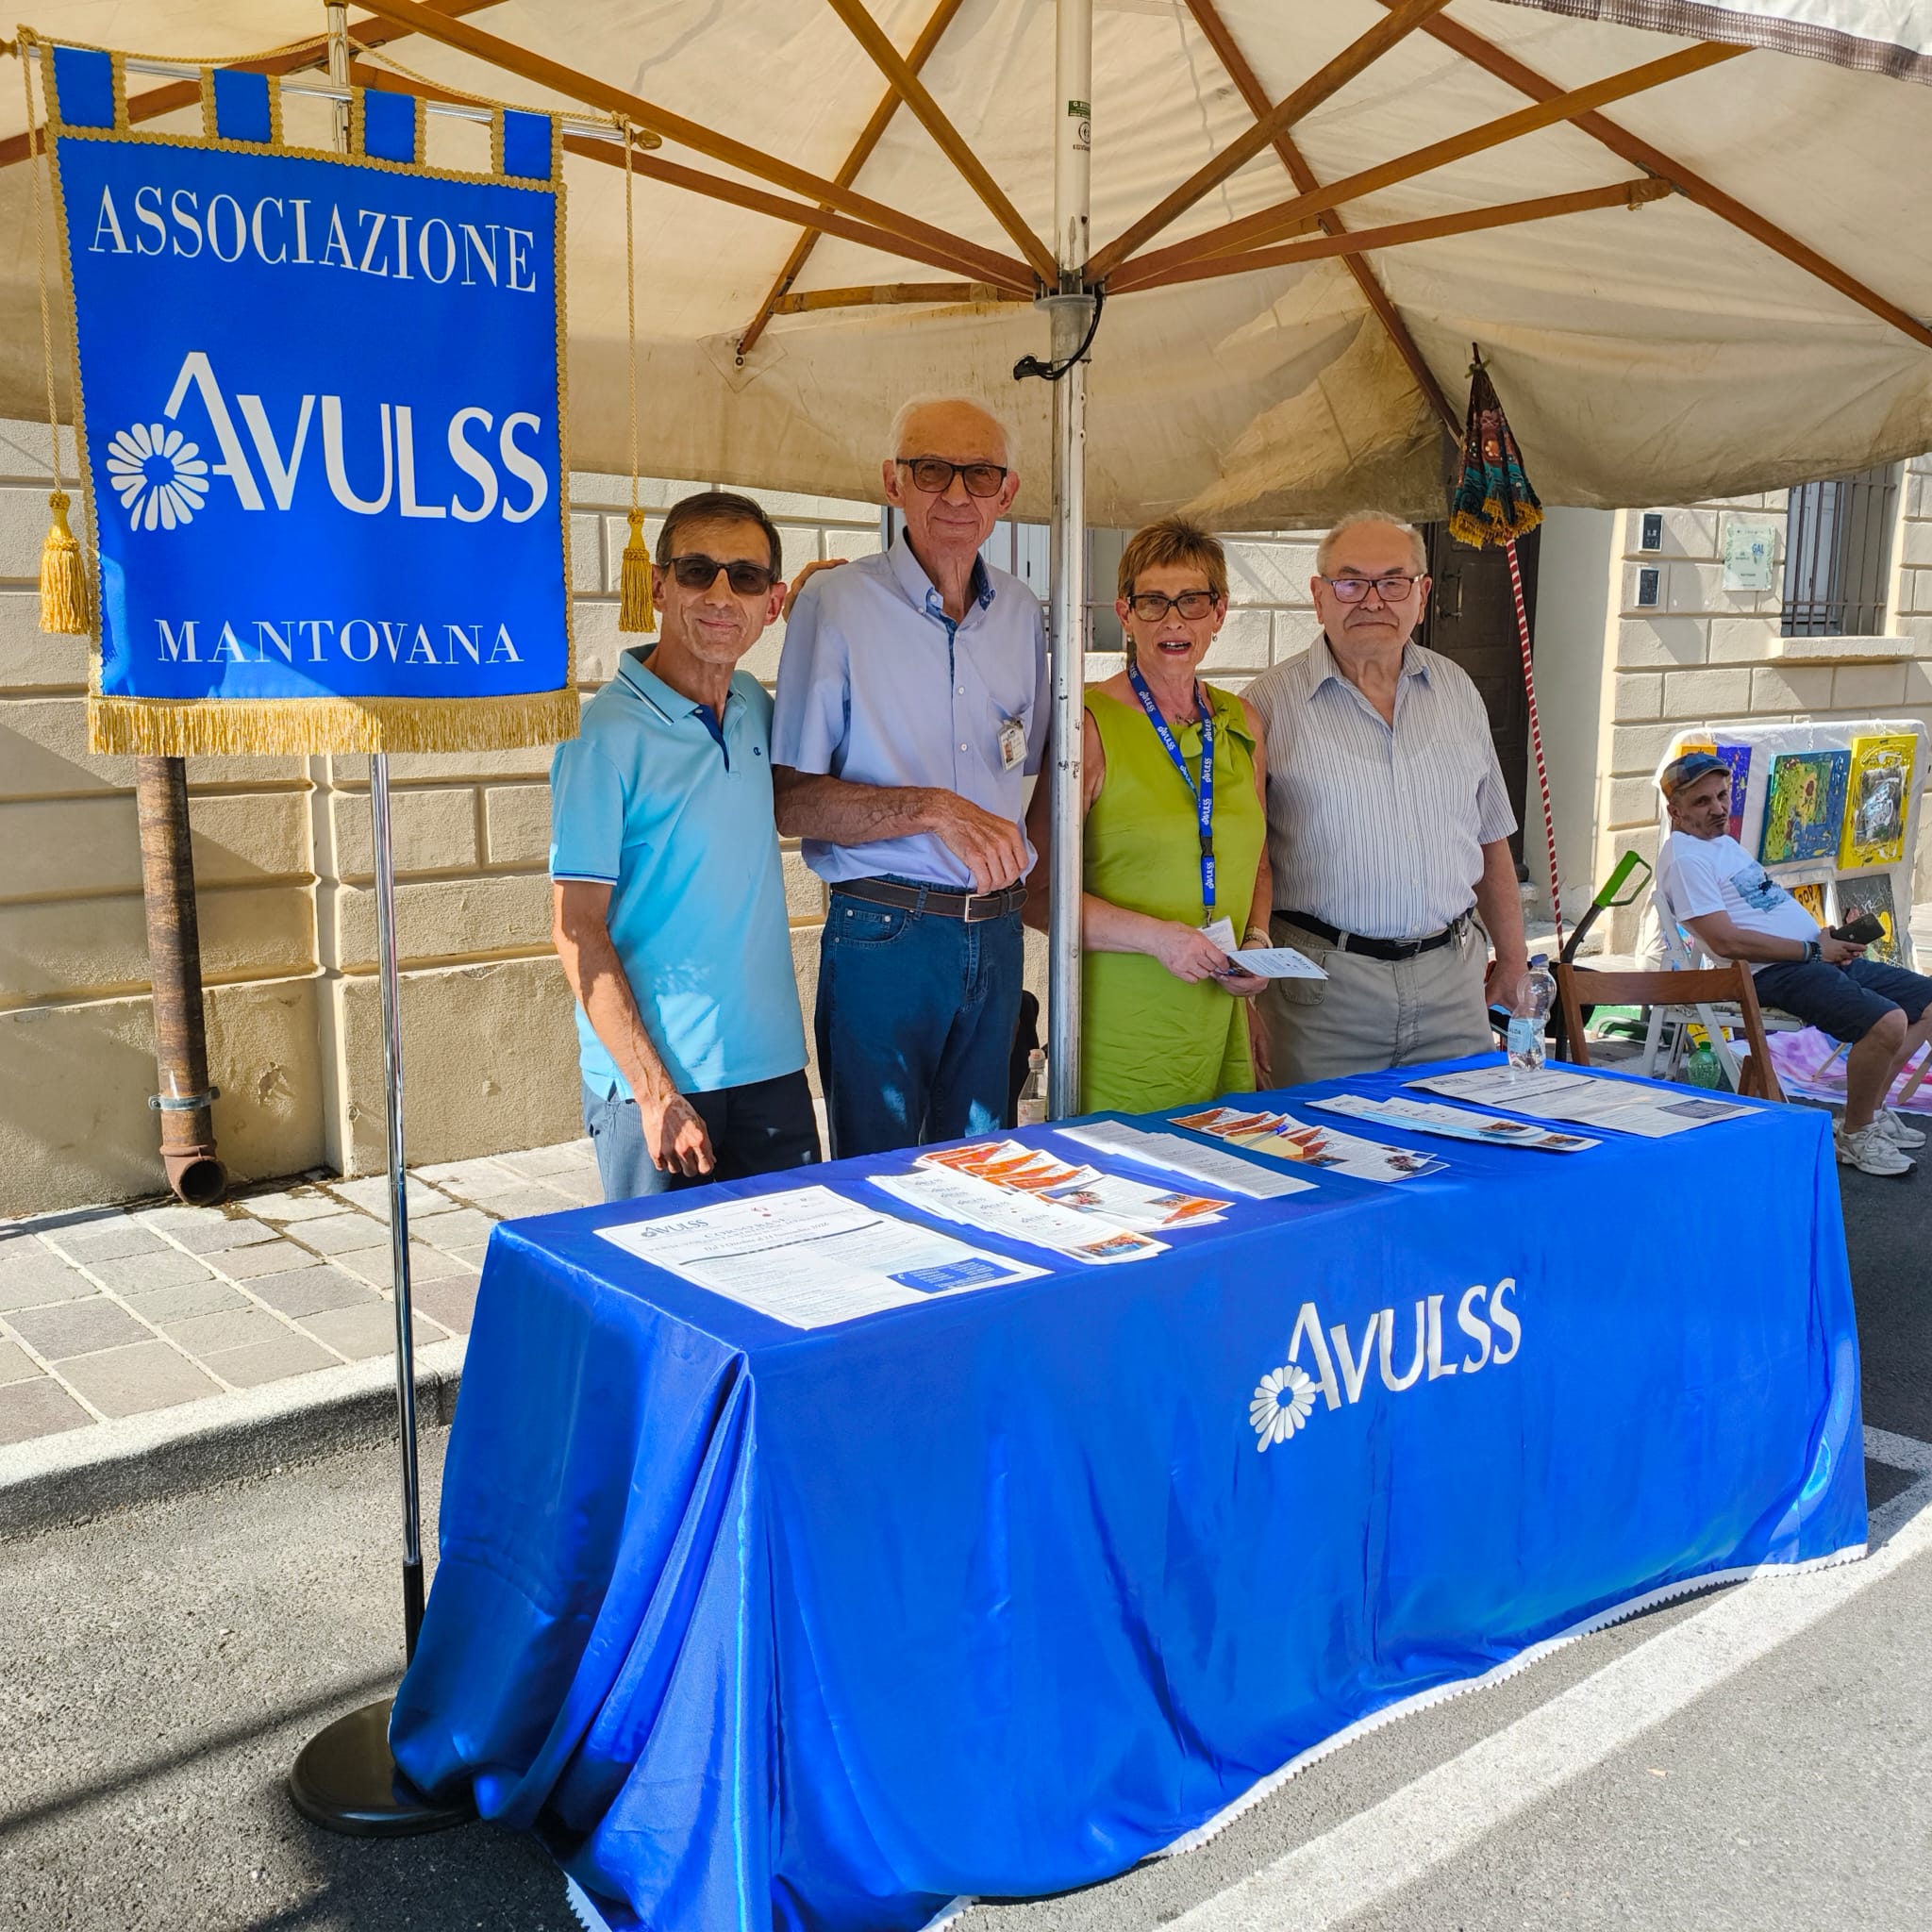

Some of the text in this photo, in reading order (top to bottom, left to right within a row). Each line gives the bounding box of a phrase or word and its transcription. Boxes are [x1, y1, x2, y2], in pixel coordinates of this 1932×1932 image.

[89, 184, 538, 293] ASSOCIAZIONE
[162, 351, 549, 525] AVULSS
[155, 618, 525, 665] MANTOVANA
[1158, 725, 1176, 752] AVULSS
[1202, 758, 1212, 783] AVULSS
[1201, 798, 1212, 826] AVULSS
[1205, 861, 1215, 890] AVULSS
[641, 1219, 709, 1237] AVULSS
[1287, 1277, 1522, 1411] AVULSS
